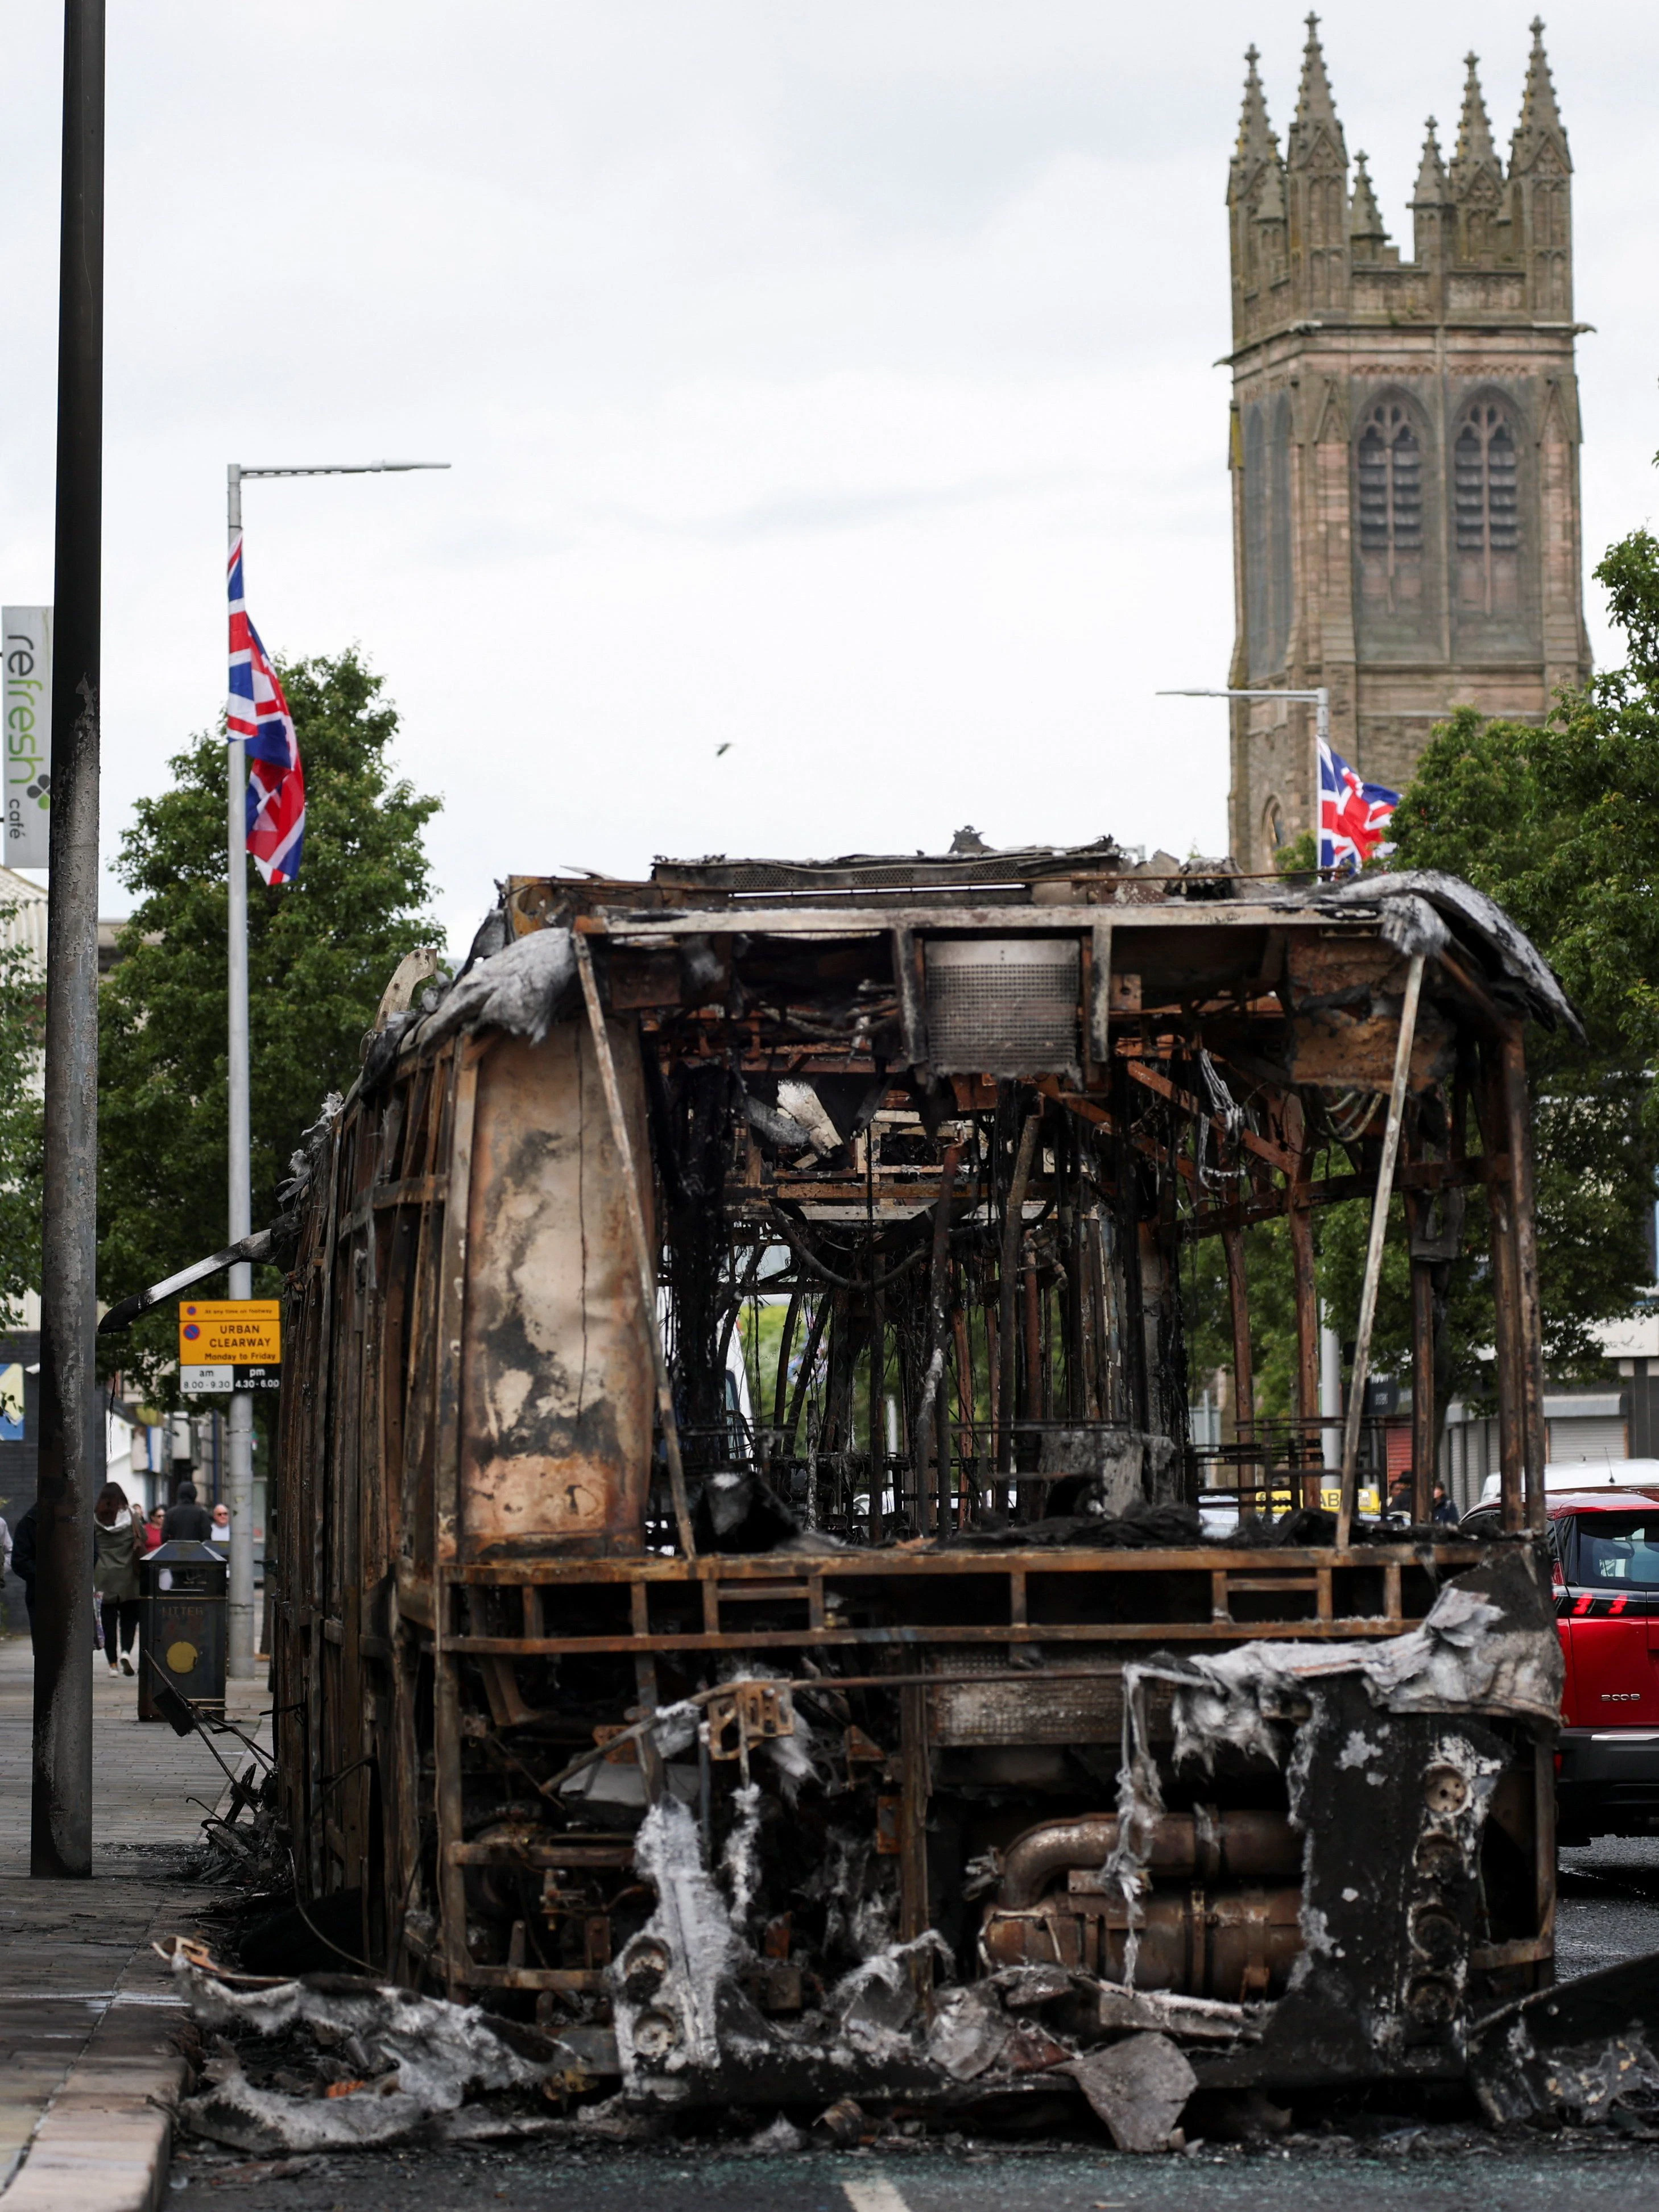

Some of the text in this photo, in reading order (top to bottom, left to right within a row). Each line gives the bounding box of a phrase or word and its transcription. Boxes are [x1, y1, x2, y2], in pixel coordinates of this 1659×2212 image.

[7, 635, 44, 784] refresh
[9, 799, 26, 839] café
[220, 1325, 260, 1334] URBAN
[209, 1338, 271, 1348] CLEARWAY
[249, 1368, 266, 1378] pm
[235, 1380, 255, 1388] 4.30
[260, 1379, 280, 1388] 6.00
[162, 1606, 204, 1616] LITTER
